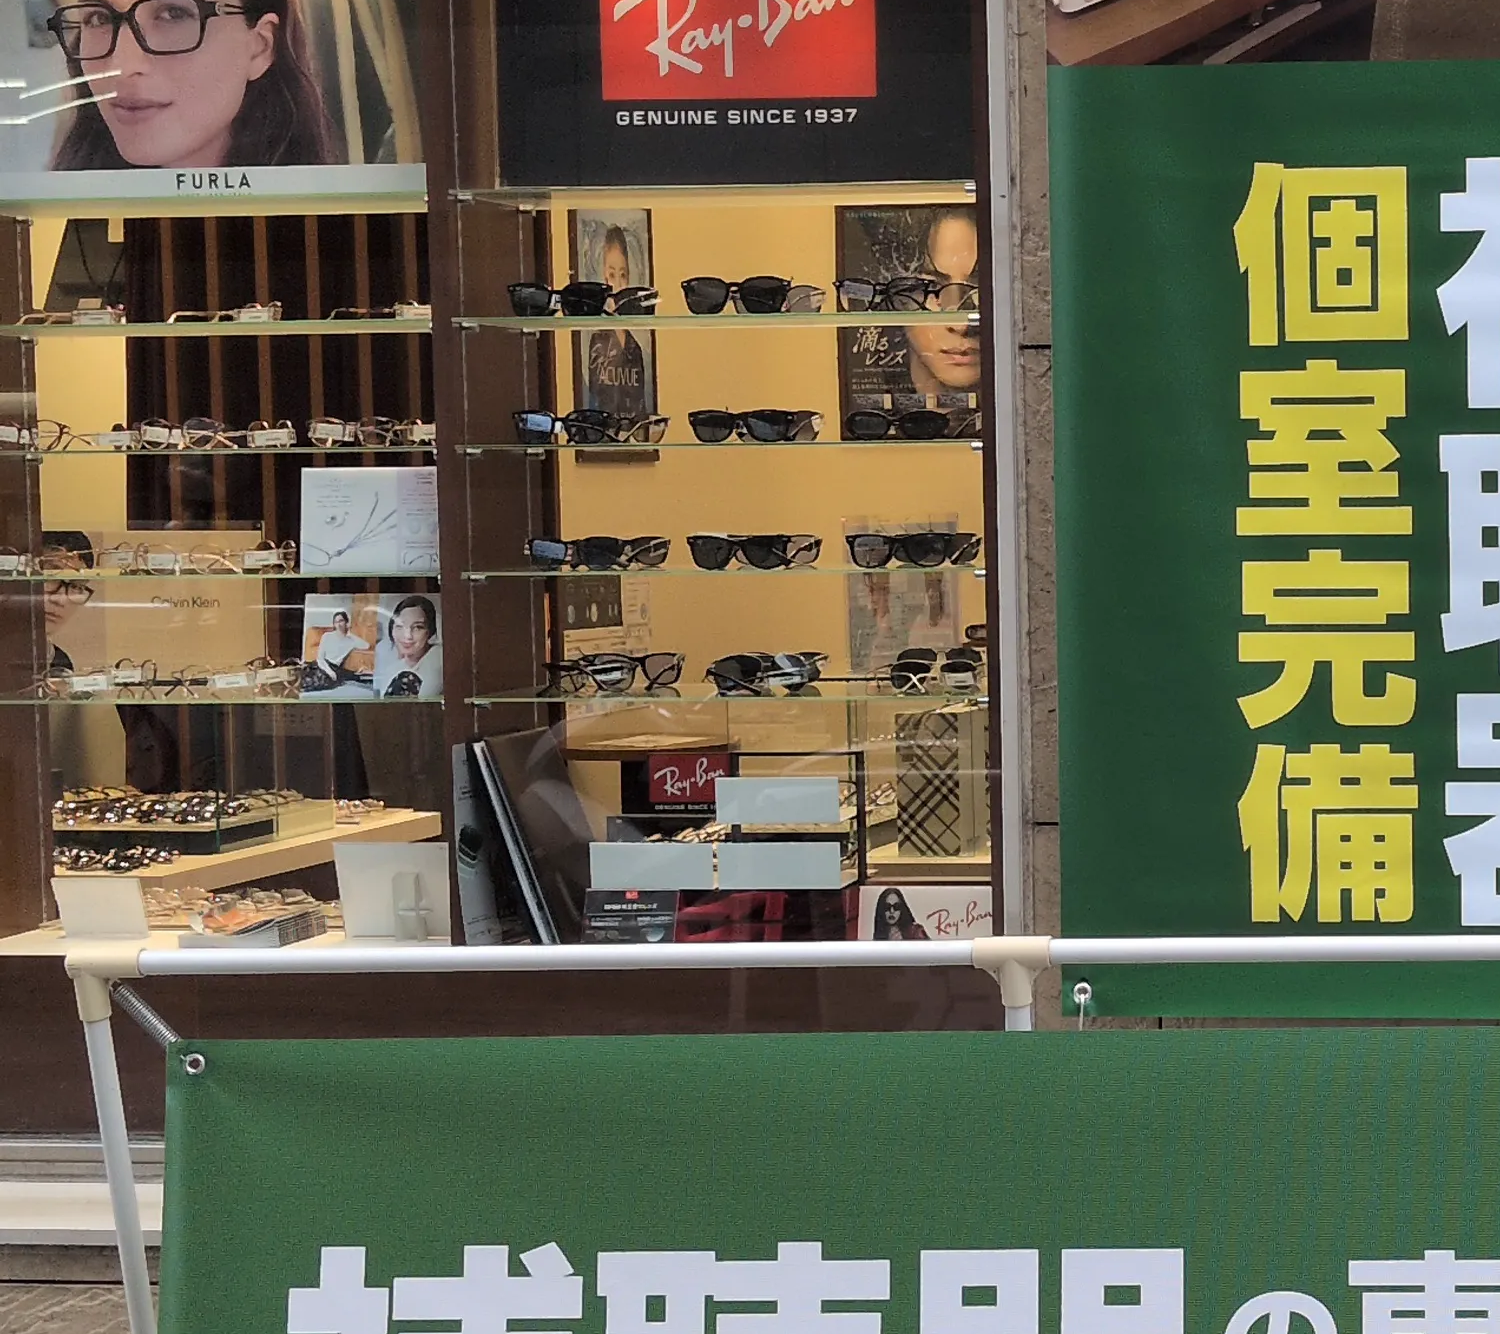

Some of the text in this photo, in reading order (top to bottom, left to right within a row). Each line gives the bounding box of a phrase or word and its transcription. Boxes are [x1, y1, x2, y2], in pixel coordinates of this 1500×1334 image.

[616, 107, 858, 126] GENUINE SINCE 1937
[176, 172, 251, 190] FURLA
[1233, 161, 1419, 924] 個室完備
[191, 595, 220, 608] Klein
